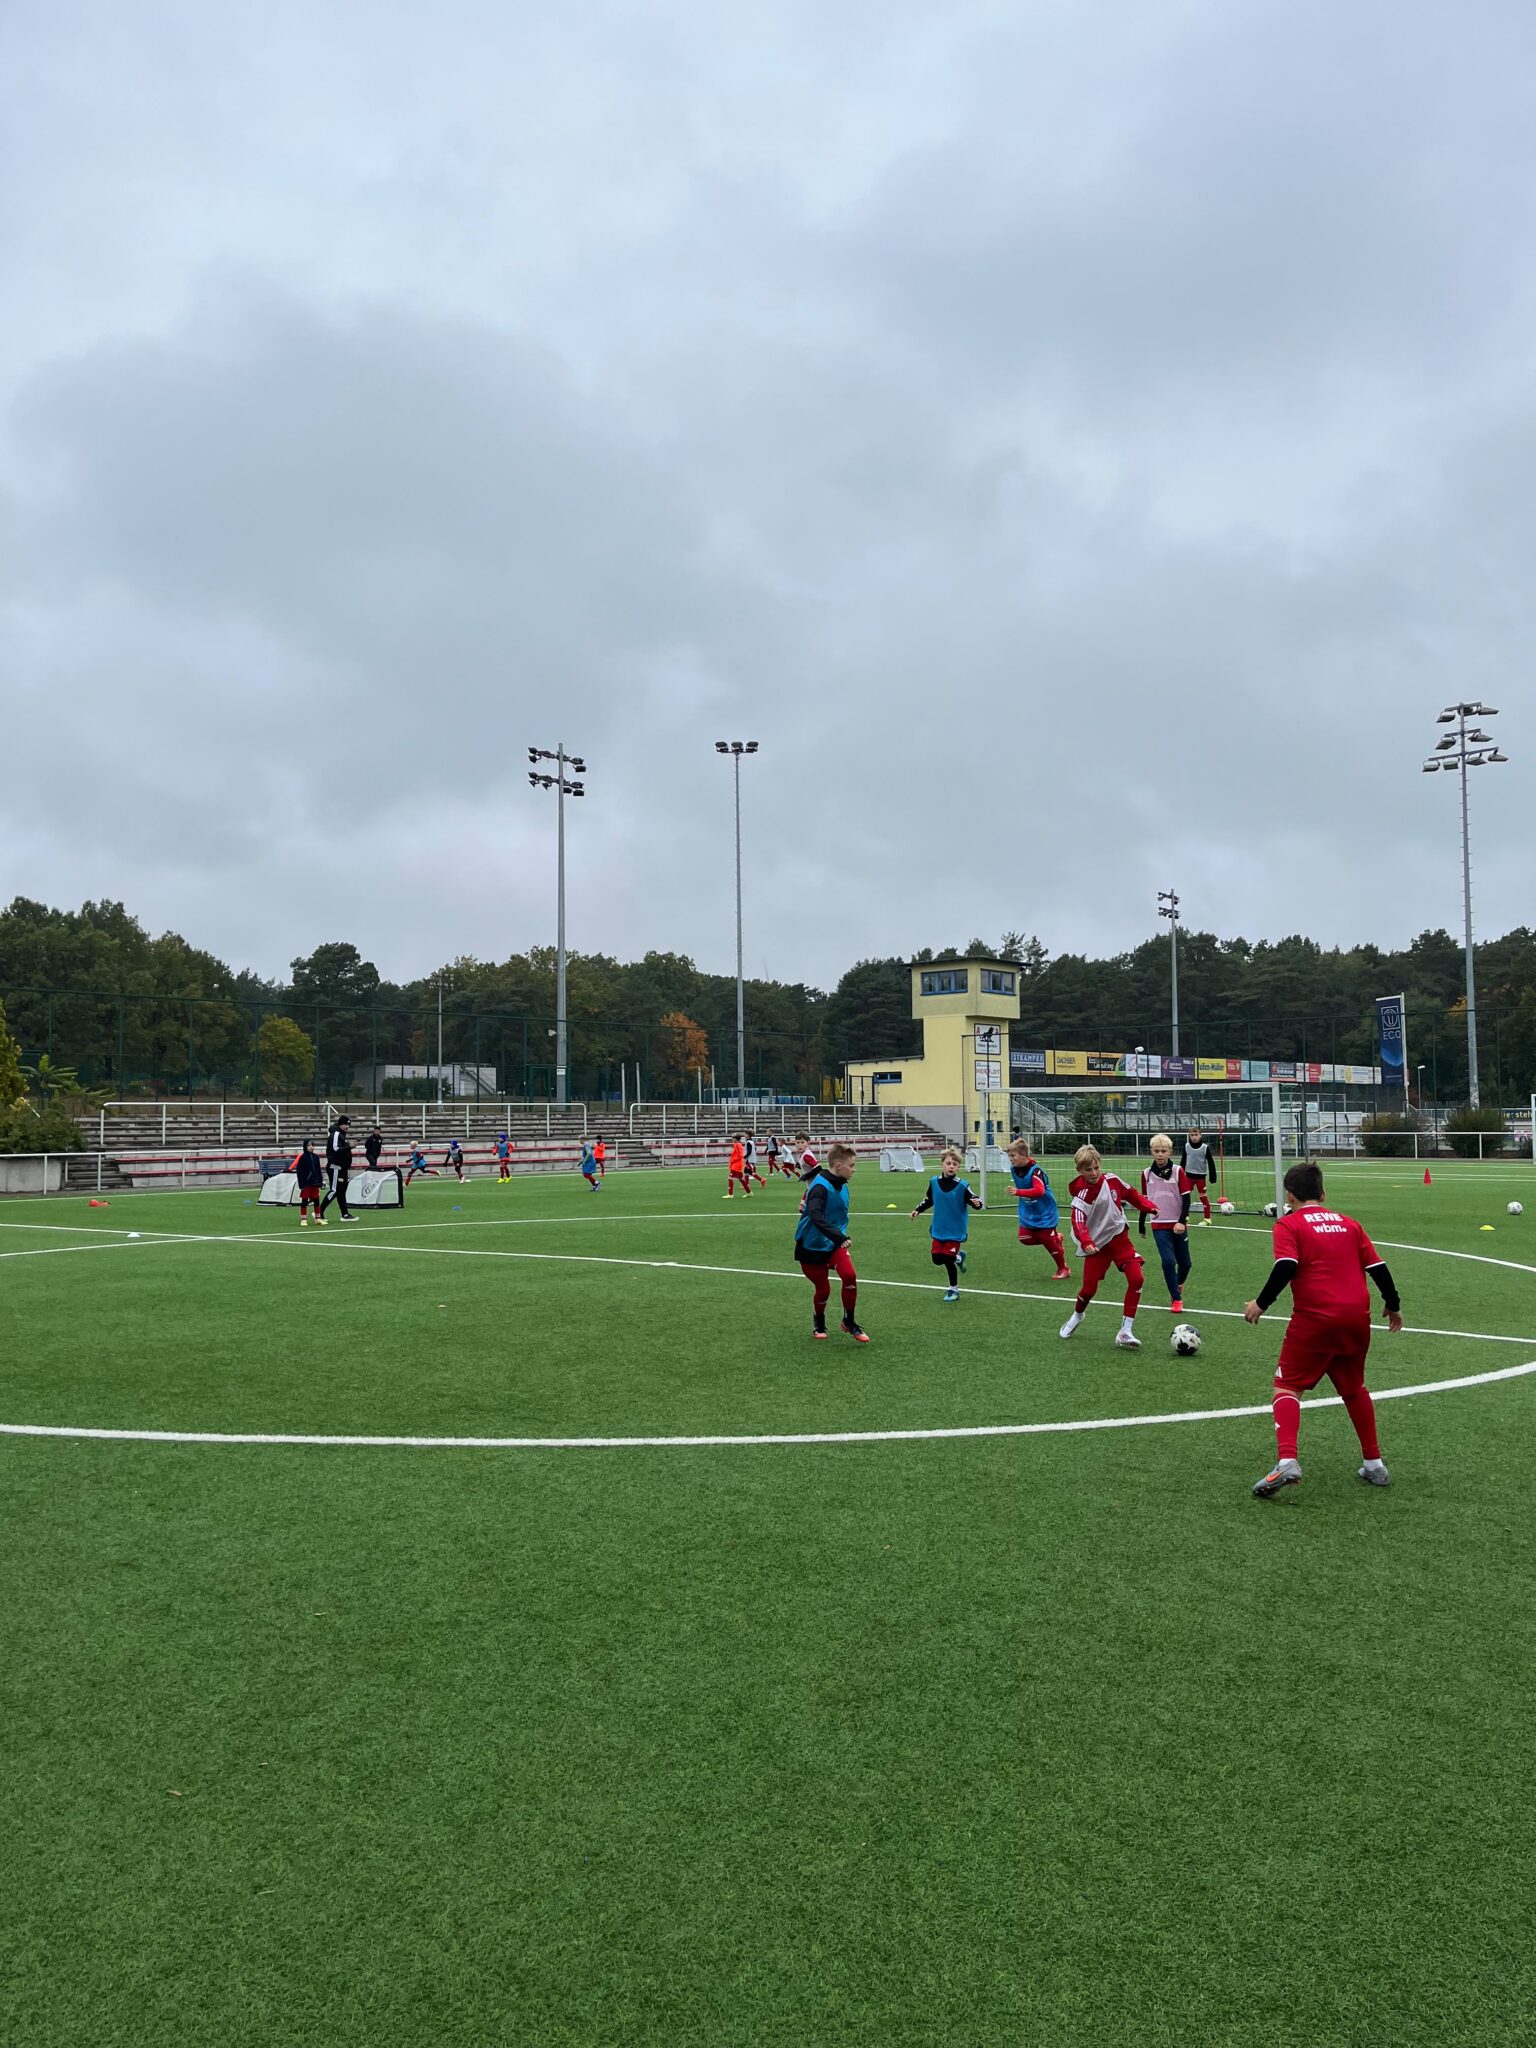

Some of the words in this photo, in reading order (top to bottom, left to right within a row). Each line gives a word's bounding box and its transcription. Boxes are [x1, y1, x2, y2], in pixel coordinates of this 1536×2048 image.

[1382, 1030, 1402, 1040] ECO
[1303, 1212, 1344, 1223] REWE
[1313, 1223, 1347, 1233] wbm.
